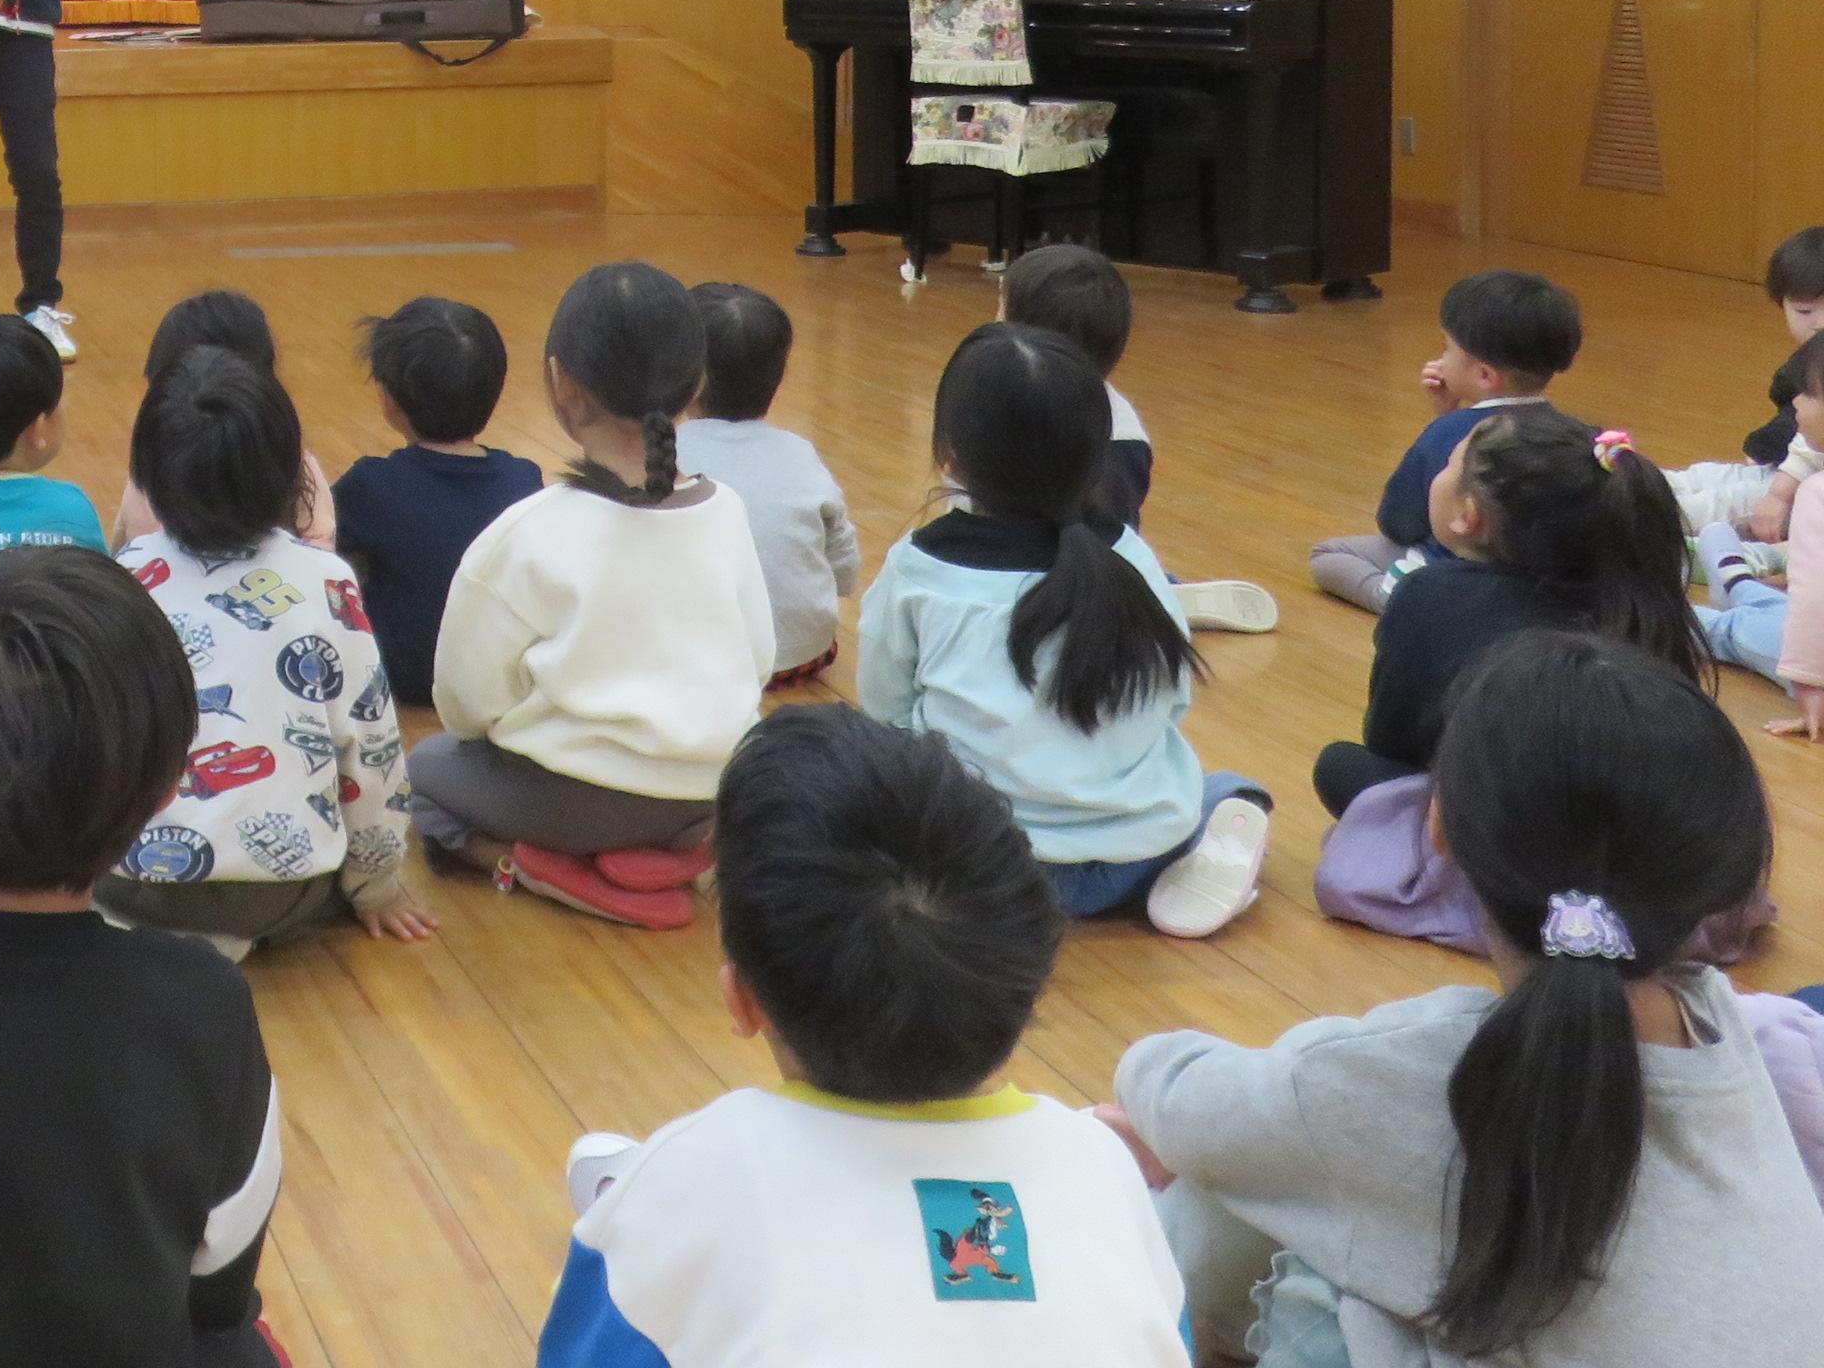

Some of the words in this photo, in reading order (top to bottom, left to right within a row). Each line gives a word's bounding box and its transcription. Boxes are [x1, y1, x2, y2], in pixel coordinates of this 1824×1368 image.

[226, 568, 306, 619] 95
[289, 637, 343, 673] PITON
[139, 828, 208, 851] PISTON
[235, 816, 313, 875] SPEED
